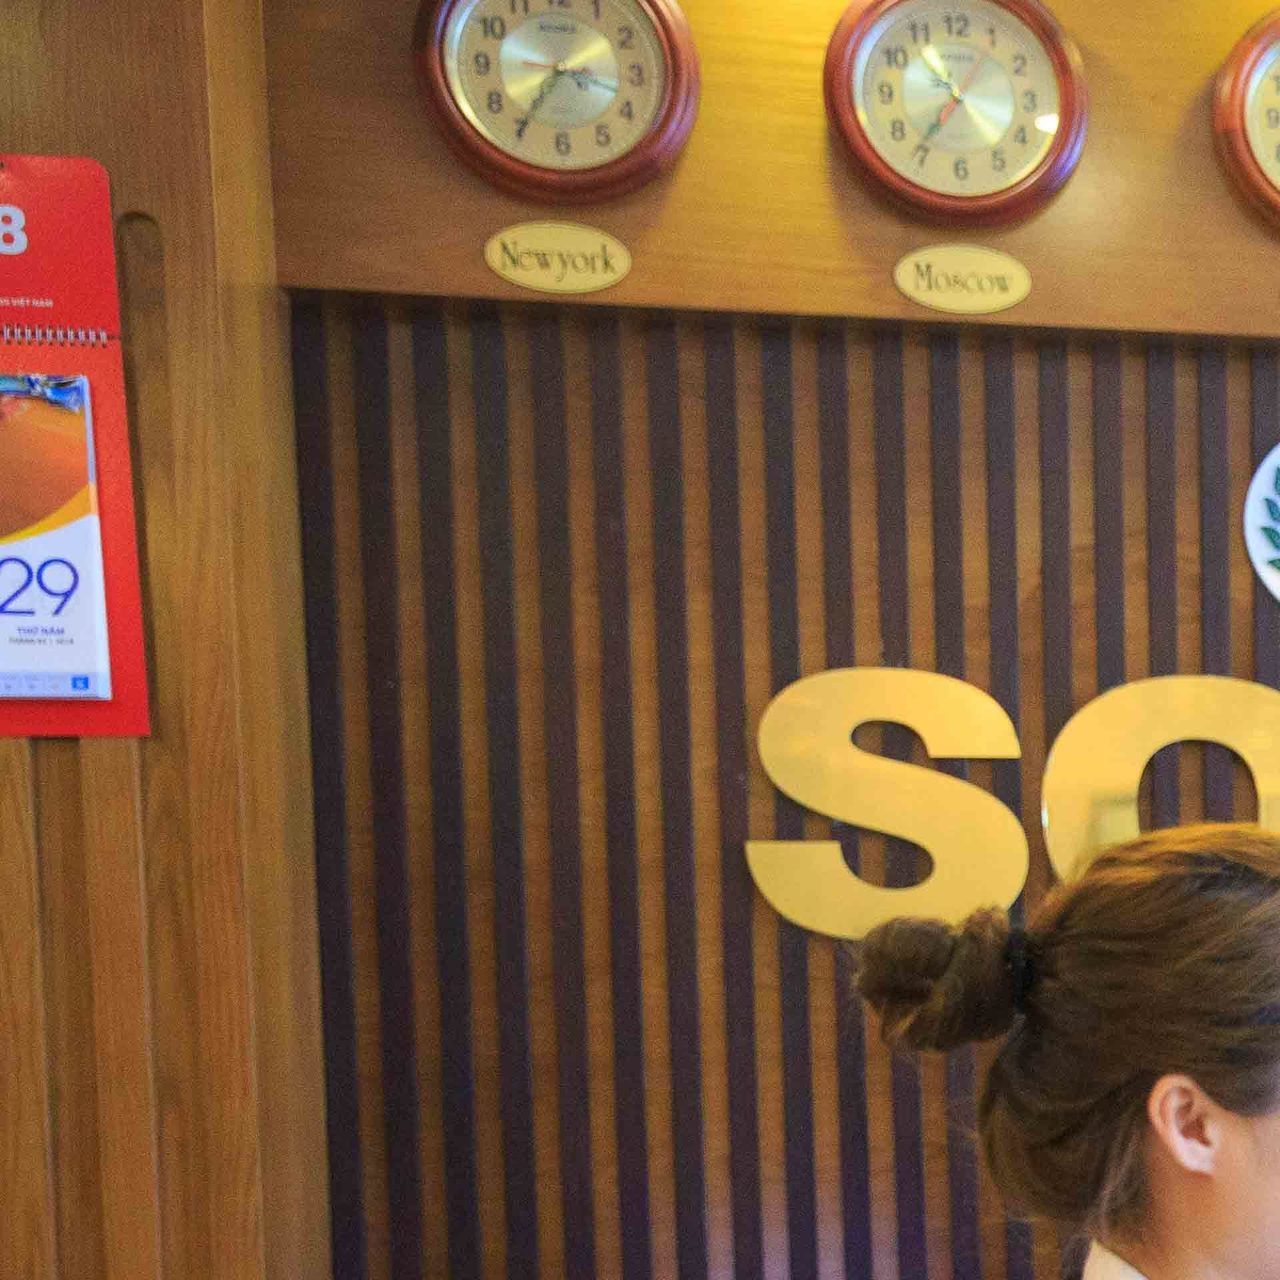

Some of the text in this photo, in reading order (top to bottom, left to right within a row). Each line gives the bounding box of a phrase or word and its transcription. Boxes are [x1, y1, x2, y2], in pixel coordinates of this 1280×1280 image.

[480, 17, 505, 39] 10
[909, 20, 931, 43] 11
[943, 15, 970, 37] 12
[987, 27, 996, 47] 1
[618, 28, 635, 49] 2
[475, 53, 490, 76] 9
[884, 48, 909, 68] 10
[1012, 53, 1028, 75] 2
[629, 63, 644, 86] 3
[488, 91, 503, 114] 8
[878, 82, 893, 105] 9
[1023, 90, 1037, 113] 3
[620, 100, 634, 120] 4
[1266, 107, 1280, 129] 9
[595, 126, 611, 146] 5
[891, 119, 906, 141] 8
[1014, 126, 1028, 147] 4
[555, 132, 571, 155] 6
[914, 145, 930, 168] 7
[992, 149, 1006, 172] 5
[954, 158, 969, 181] 6
[0, 557, 79, 616] 29
